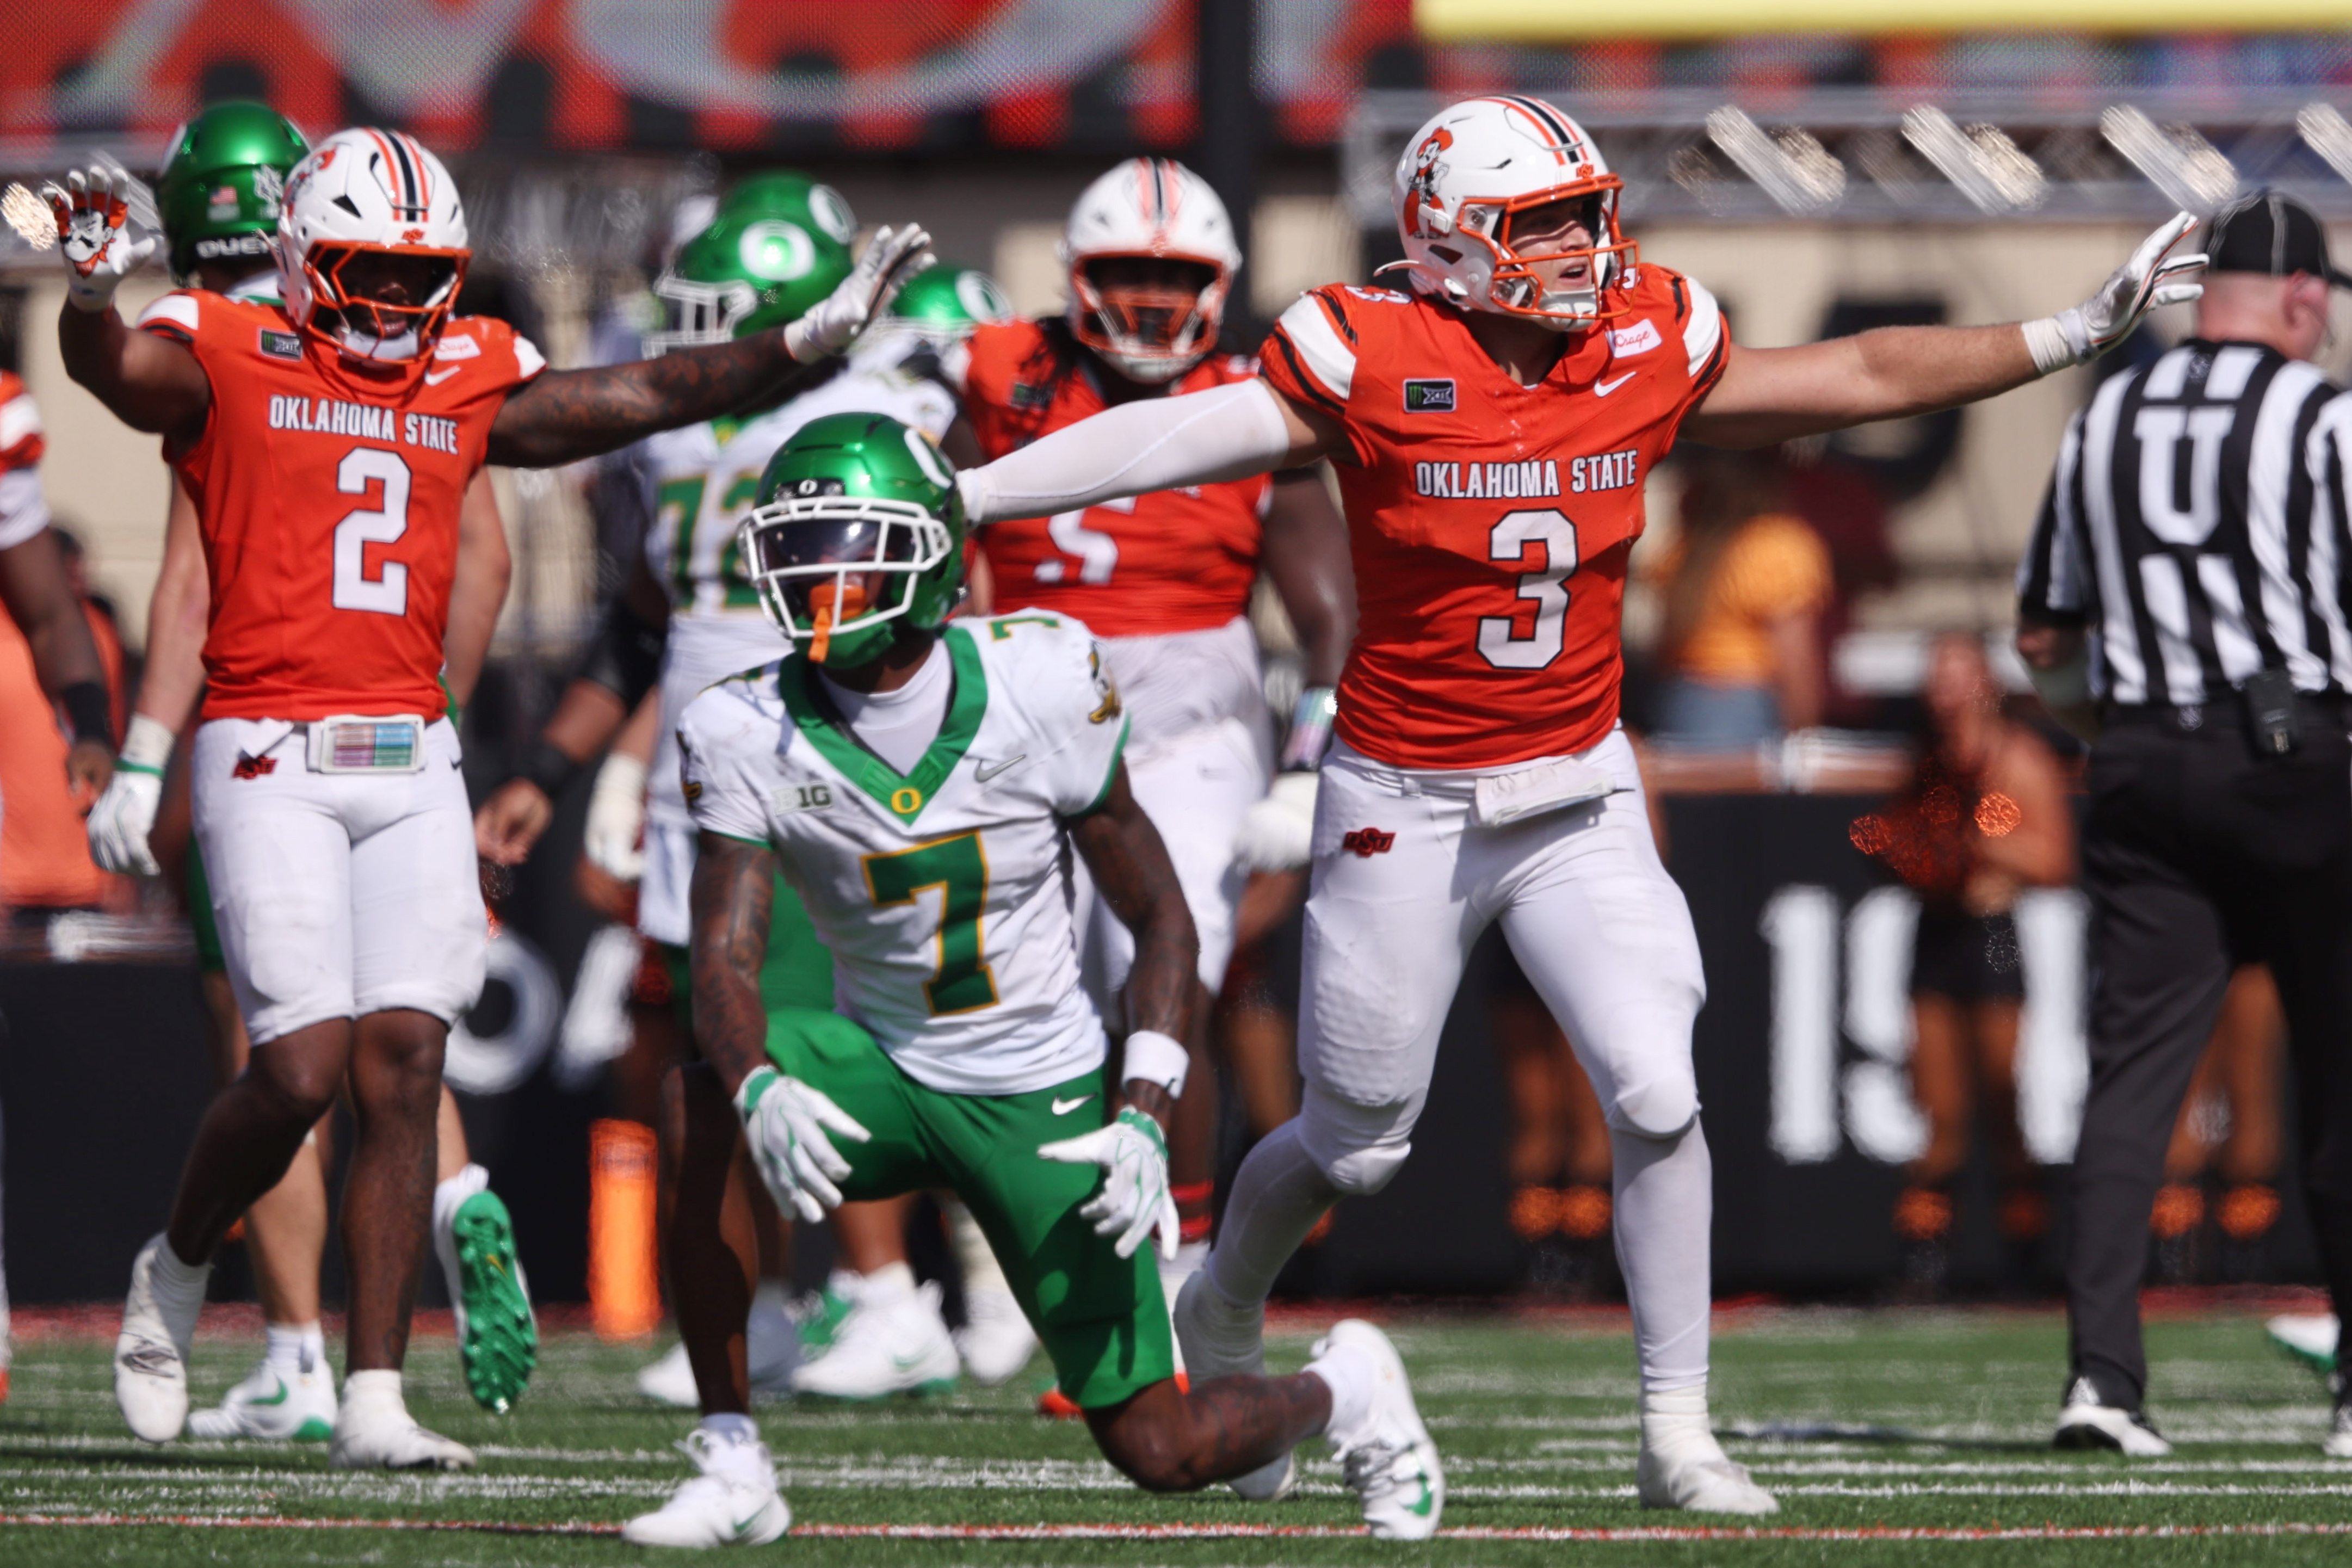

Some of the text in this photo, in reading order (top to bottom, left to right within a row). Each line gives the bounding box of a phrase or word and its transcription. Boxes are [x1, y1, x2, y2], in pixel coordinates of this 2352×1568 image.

[269, 394, 459, 455] OKLAHOMA STATE
[1415, 449, 1638, 499] OKLAHOMA STATE
[2132, 405, 2237, 546] U
[332, 446, 412, 618] 2
[1476, 508, 1579, 671] 3
[890, 787, 922, 814] O
[859, 828, 1000, 1017] 7
